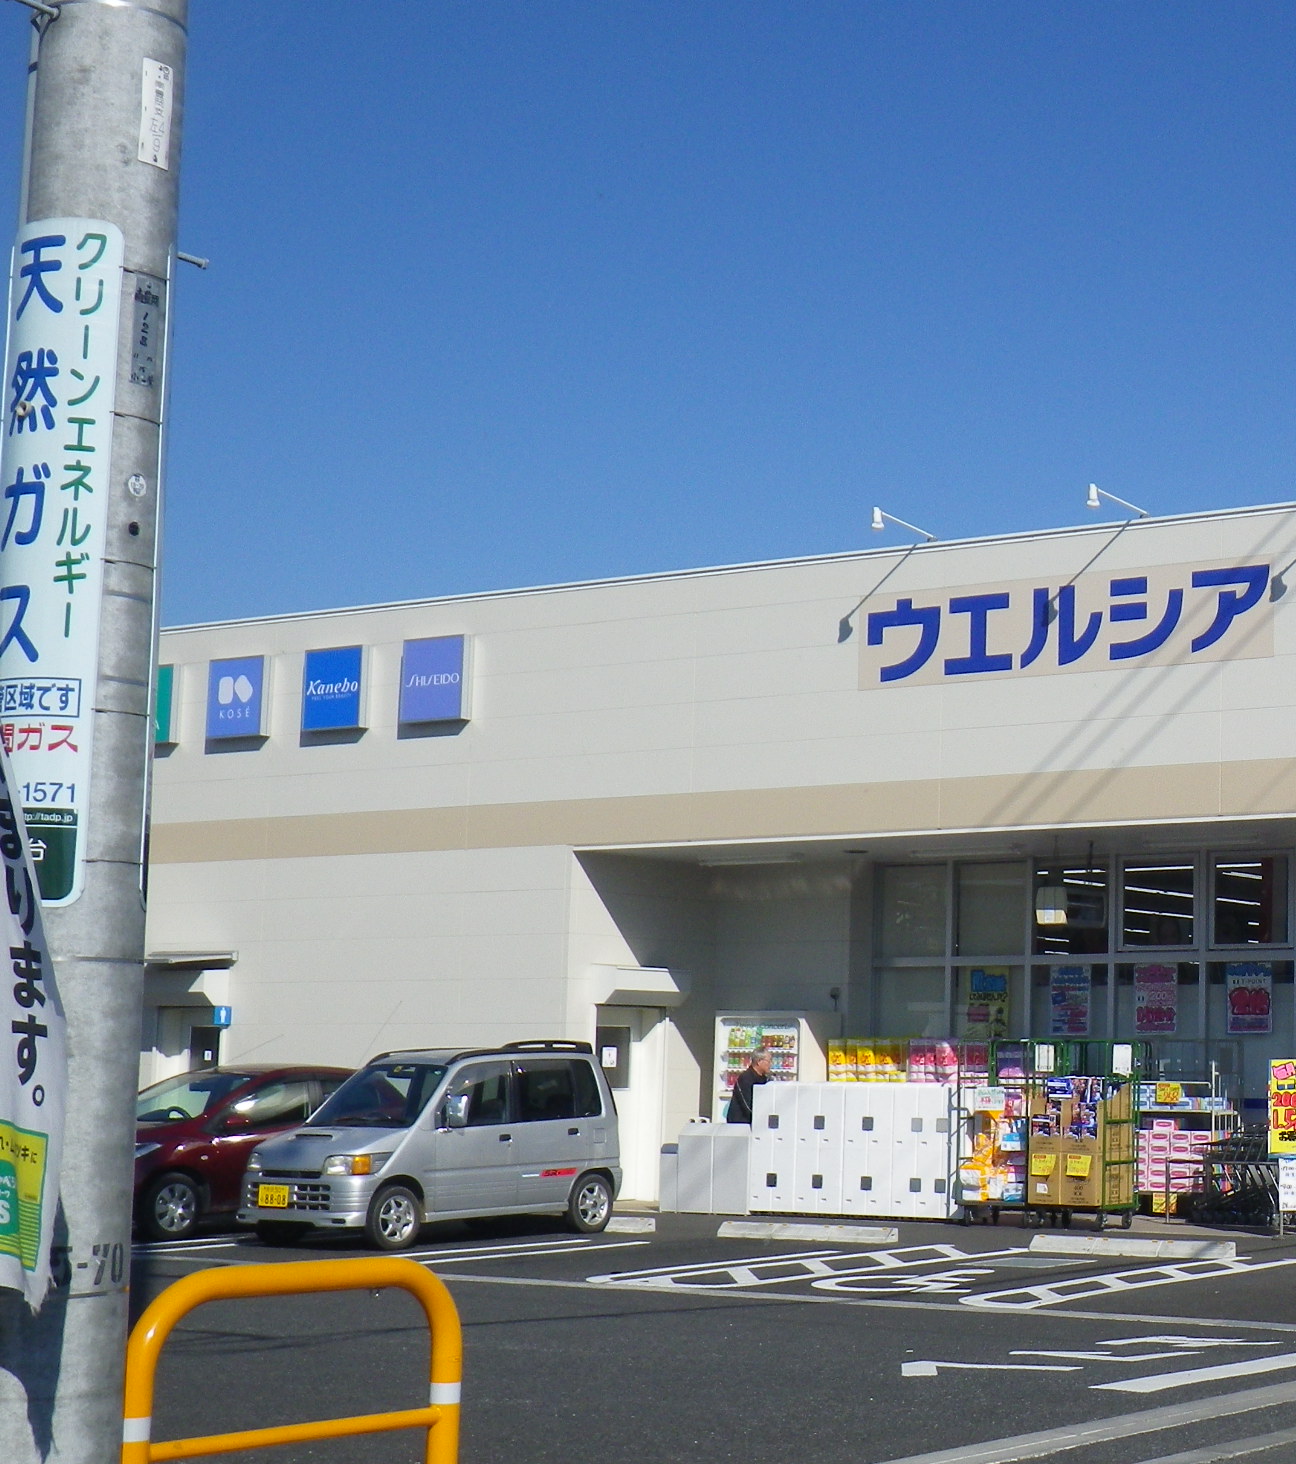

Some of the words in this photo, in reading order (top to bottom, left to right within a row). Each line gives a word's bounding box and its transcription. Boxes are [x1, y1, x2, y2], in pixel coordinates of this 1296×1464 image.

[1, 234, 66, 663] 天然ガス
[53, 233, 107, 637] クリーンエネルギー
[867, 563, 1270, 682] ウエルシア
[0, 683, 75, 711] 区域です
[306, 677, 358, 695] Kanebo
[406, 672, 460, 688] SHISEIDO
